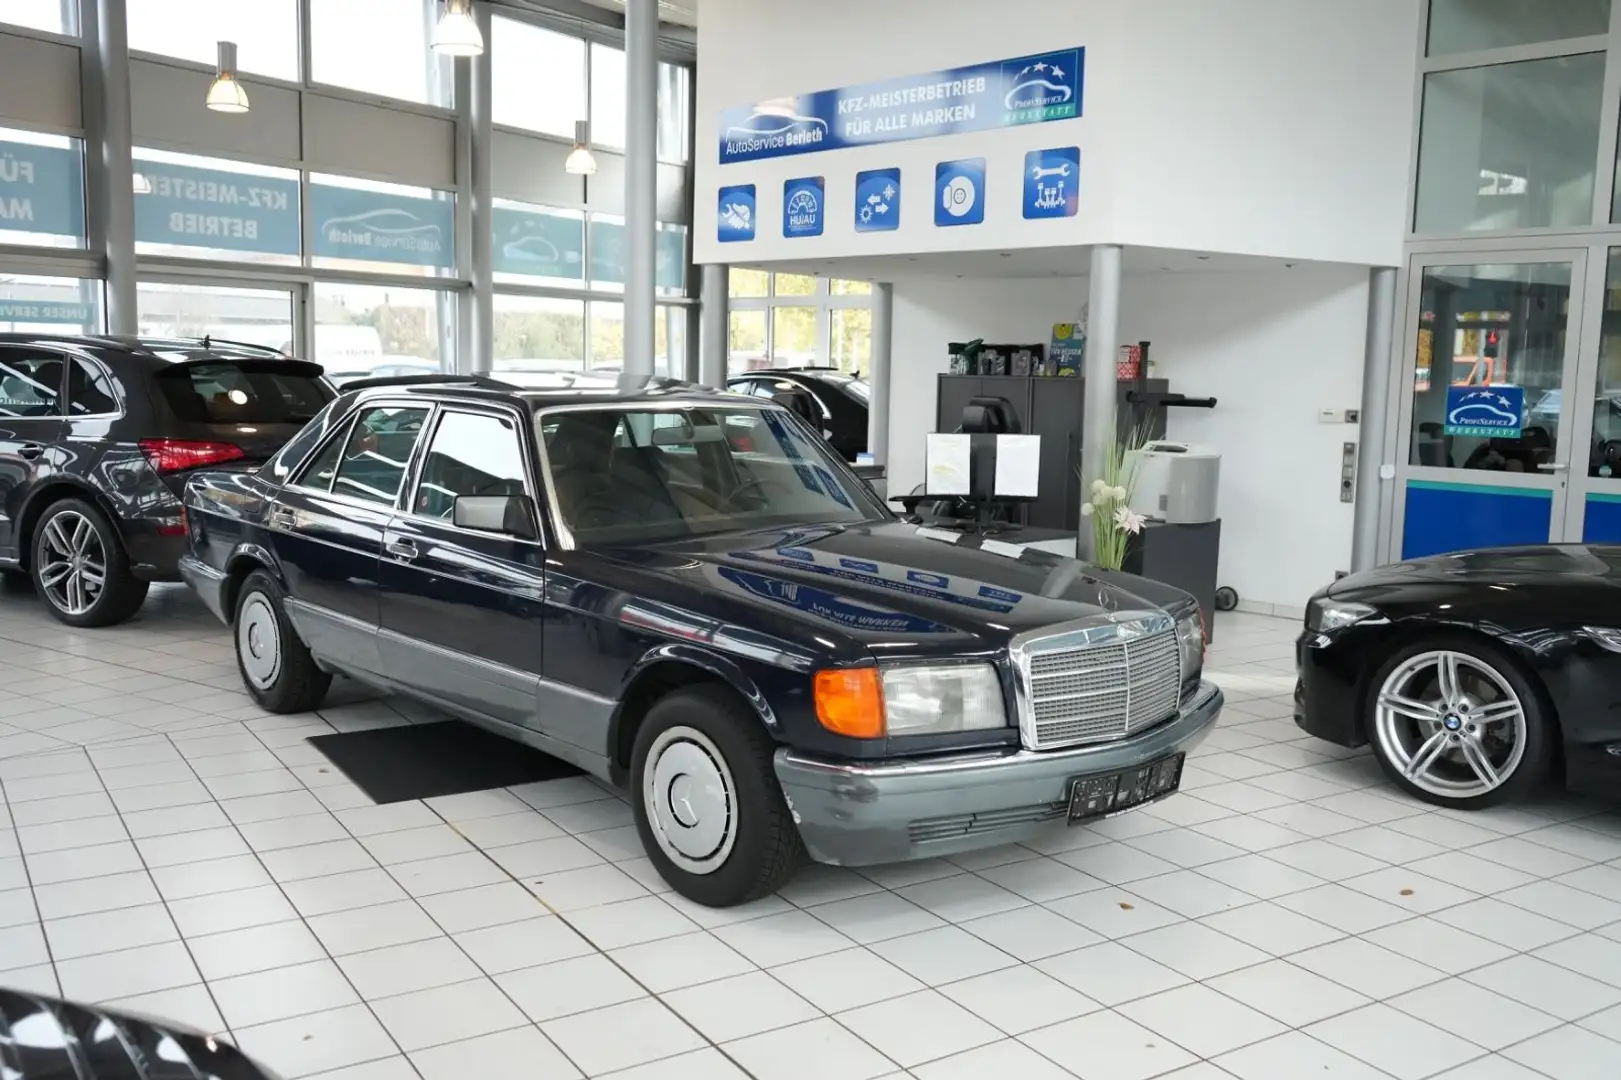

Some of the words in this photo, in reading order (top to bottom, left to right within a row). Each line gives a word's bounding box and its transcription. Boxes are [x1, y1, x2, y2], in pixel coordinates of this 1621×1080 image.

[838, 77, 986, 115] KFZ-MEISTERBETRIEB
[845, 117, 871, 137] FÜR
[875, 114, 907, 132] ALLE
[911, 103, 976, 127] MARKEN
[726, 135, 784, 155] AutoService
[785, 127, 823, 146] Berleth
[1449, 427, 1516, 436] WERKSTATT
